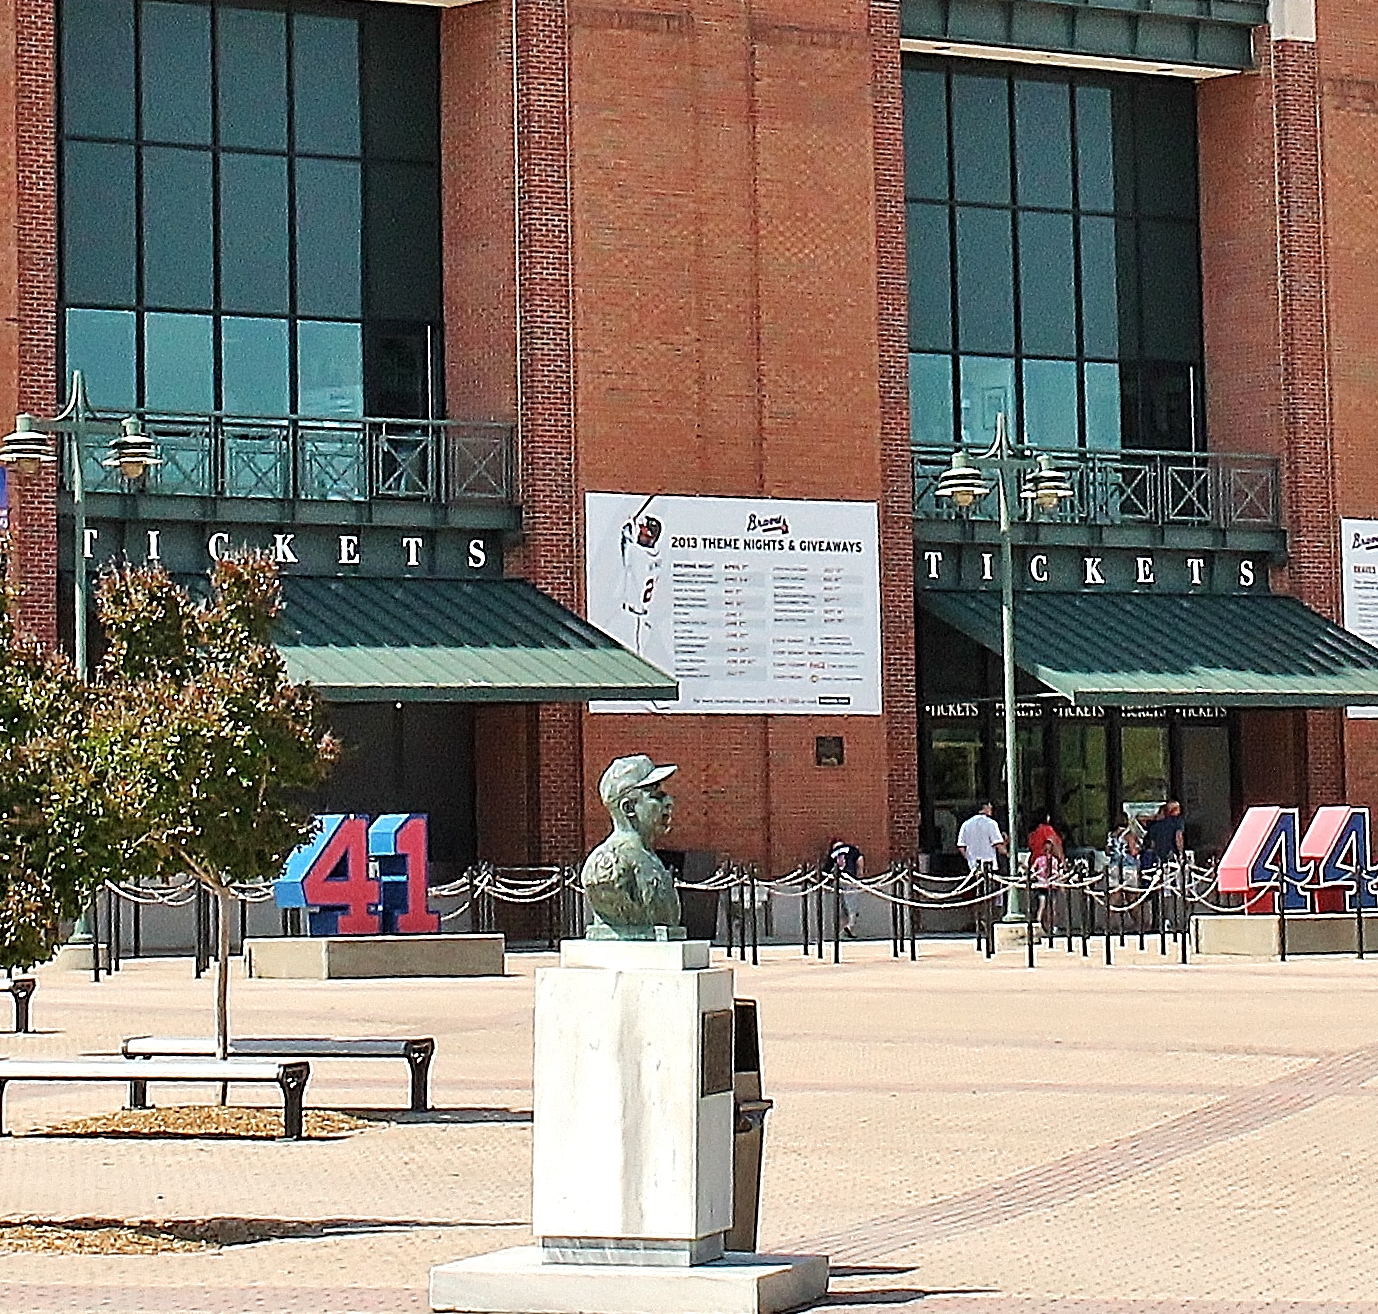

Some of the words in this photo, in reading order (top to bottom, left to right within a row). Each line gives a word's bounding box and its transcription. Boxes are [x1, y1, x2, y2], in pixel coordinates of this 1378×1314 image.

[82, 529, 488, 568] TICKETS
[671, 536, 697, 549] 2013
[702, 537, 739, 550] THEME
[744, 538, 785, 551] NIGHTS
[789, 540, 795, 551] &
[800, 540, 863, 553] GIVEAWAYS
[924, 551, 1255, 586] TICKETS
[931, 702, 979, 717] TICKETS
[277, 813, 441, 935] 41
